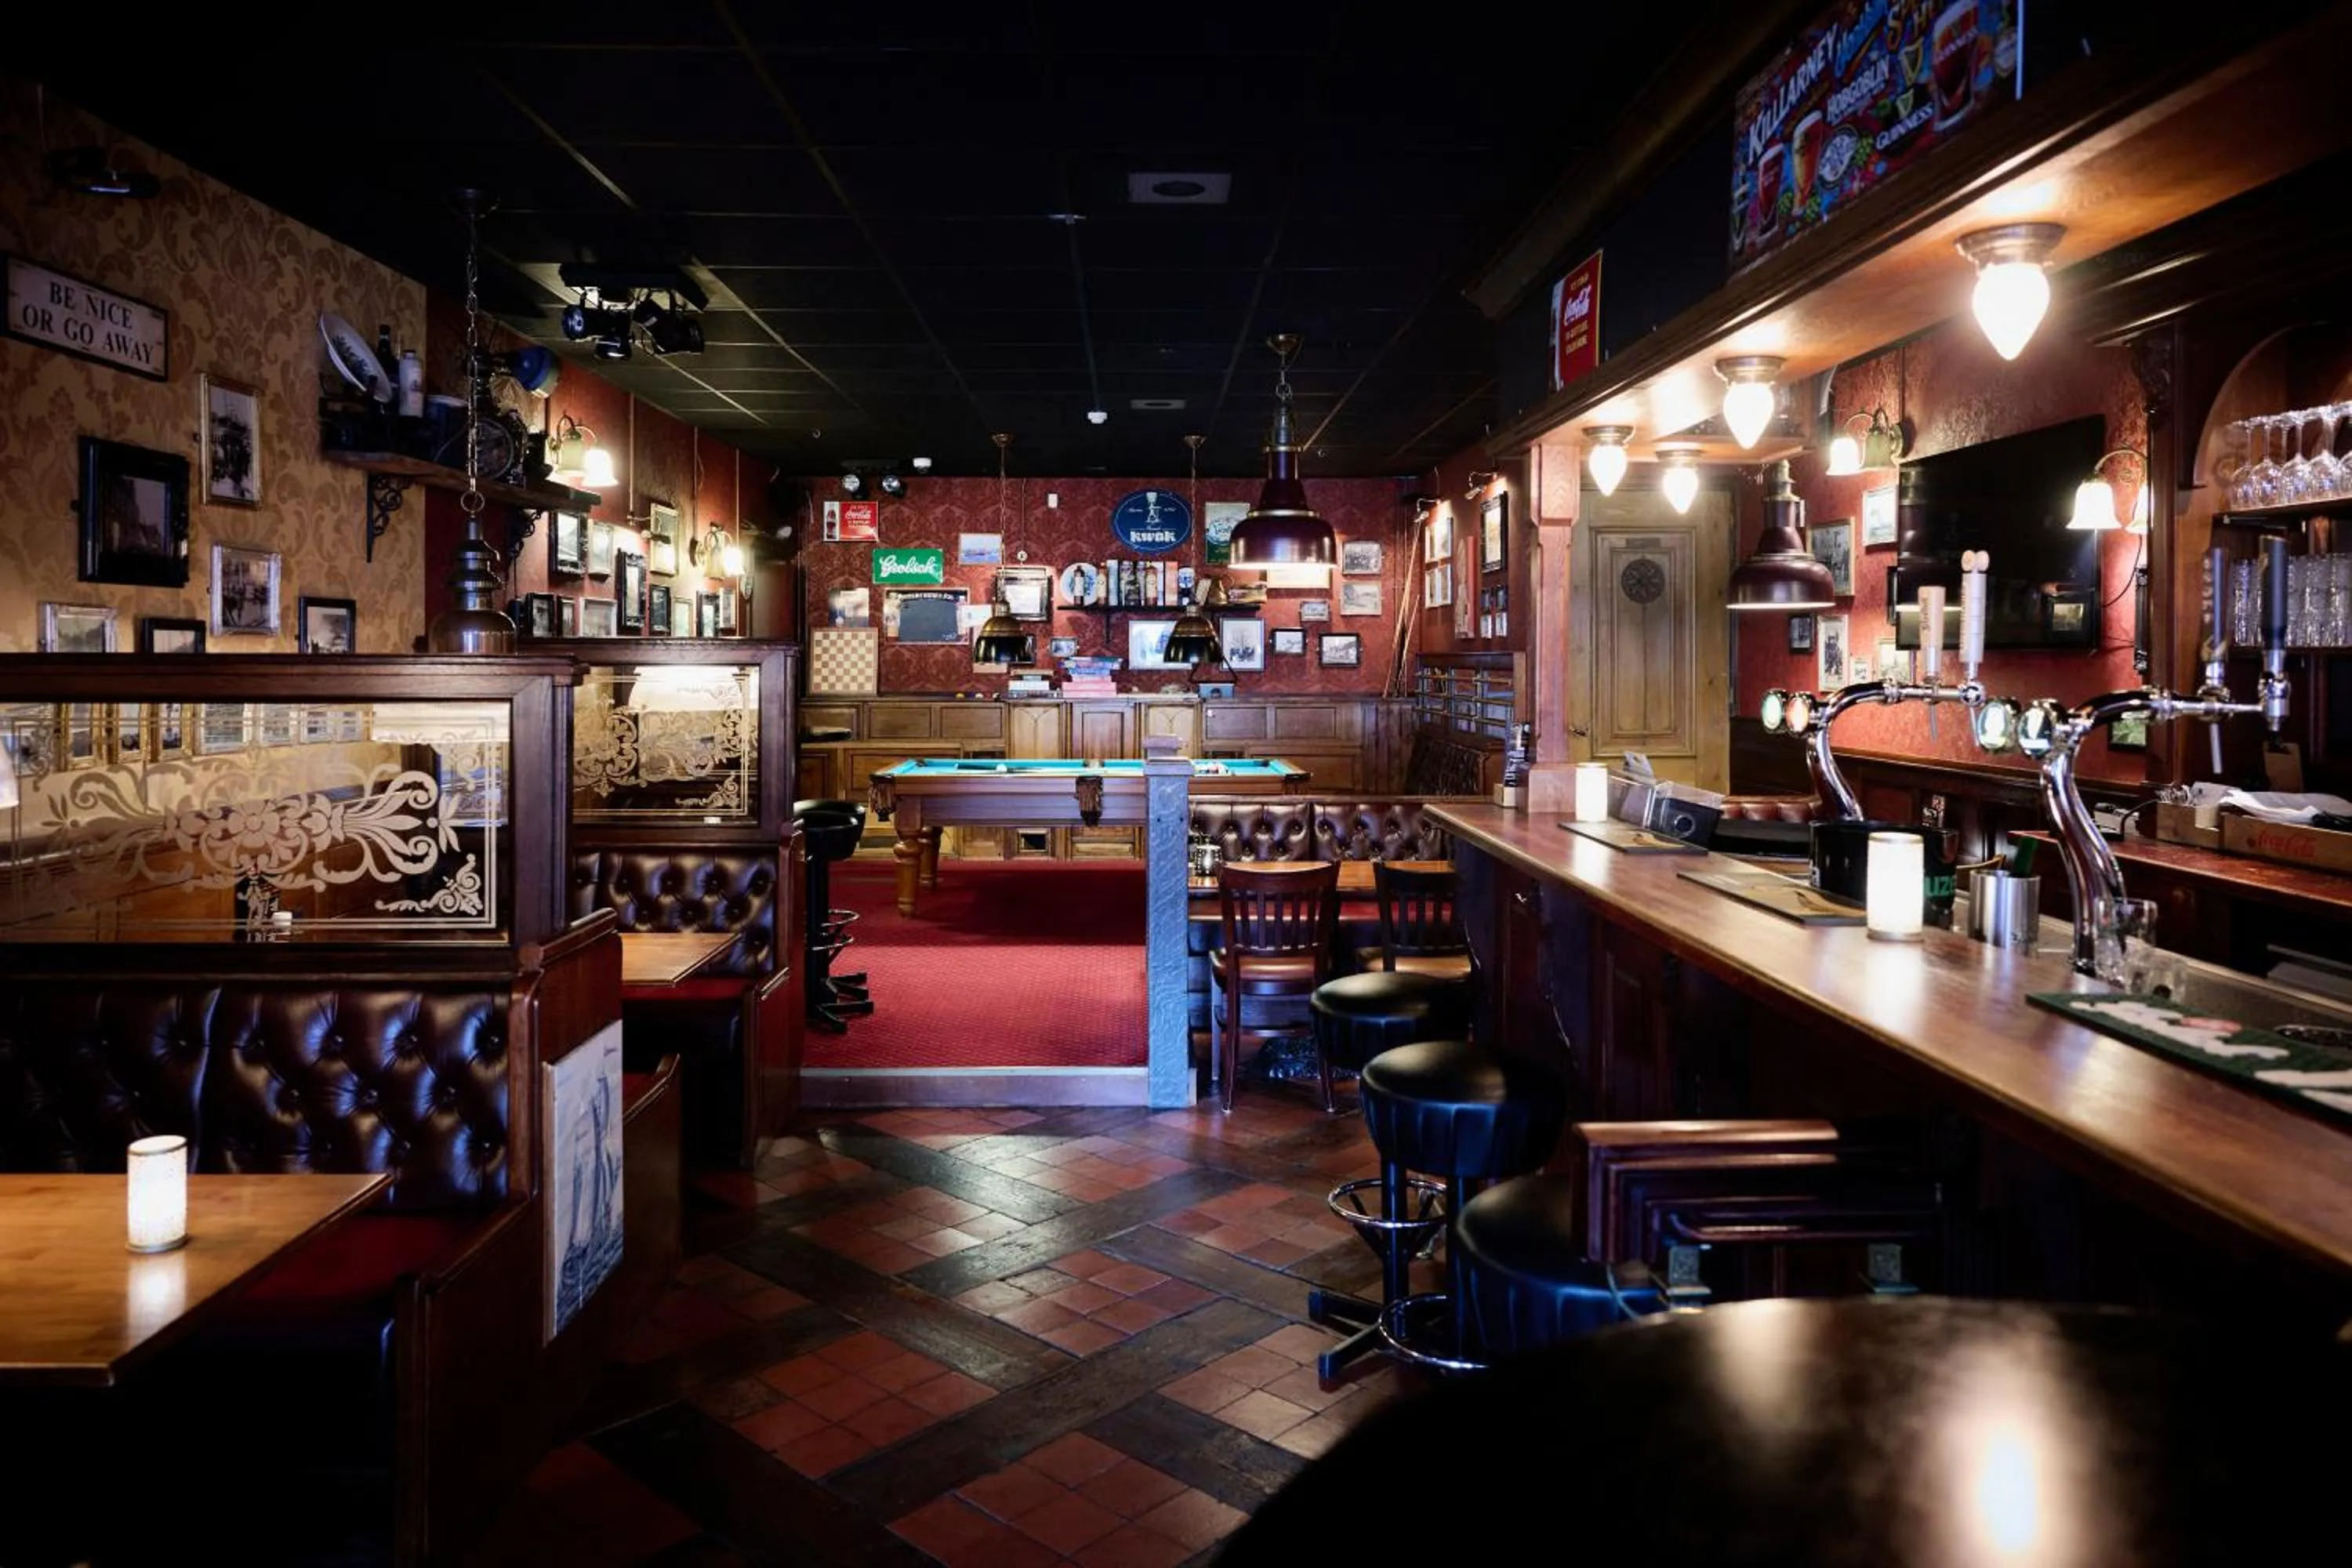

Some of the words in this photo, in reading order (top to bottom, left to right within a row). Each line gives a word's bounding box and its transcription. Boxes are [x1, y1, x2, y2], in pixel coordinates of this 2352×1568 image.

[1748, 22, 1840, 167] KILLARNEY
[1876, 102, 1934, 150] GUINNESS
[49, 281, 76, 310] BE
[85, 294, 133, 329] NICE
[23, 303, 54, 334] OR
[64, 317, 94, 346] GO
[103, 330, 154, 365] AWAY
[879, 554, 937, 578] Grolsch
